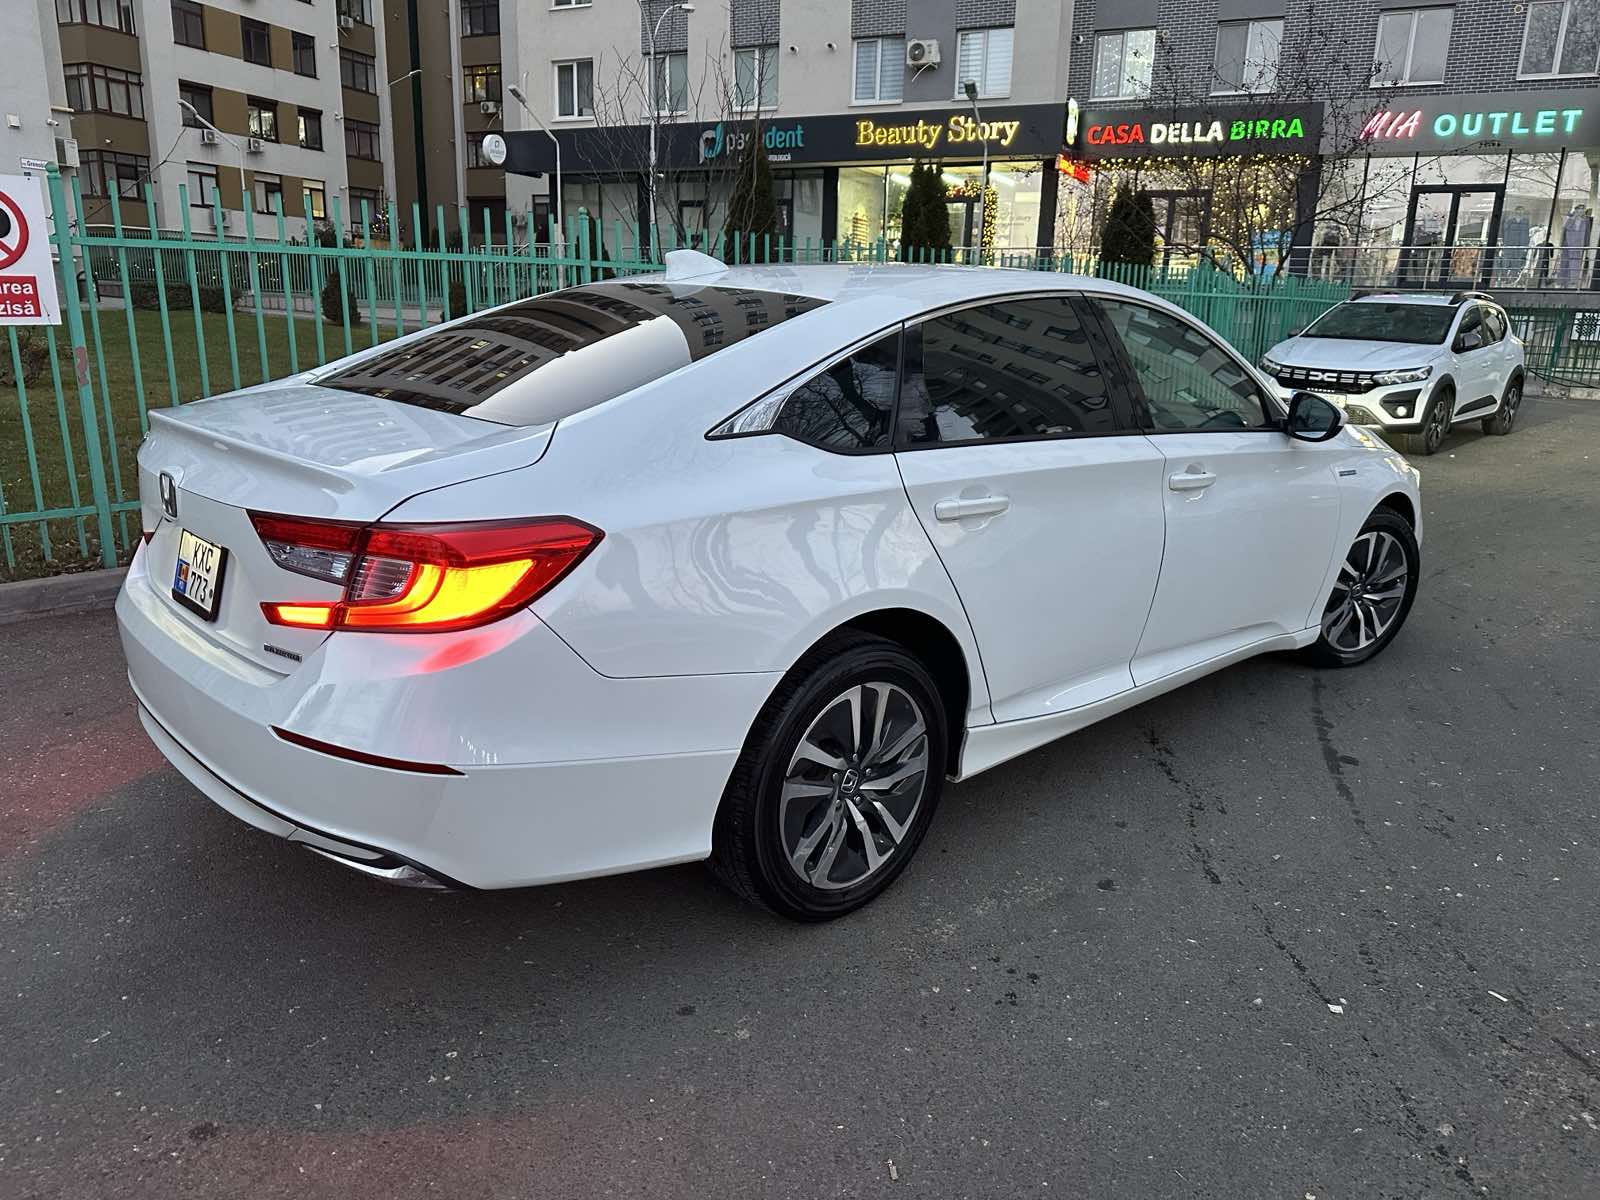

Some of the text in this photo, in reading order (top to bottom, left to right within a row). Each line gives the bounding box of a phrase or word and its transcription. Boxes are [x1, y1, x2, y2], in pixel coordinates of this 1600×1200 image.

[855, 115, 1020, 149] Beauty Story
[1086, 118, 1305, 145] CASA DELLA BIRRA
[1359, 109, 1583, 139] MIA OUTLET
[0, 282, 34, 295] rea
[193, 541, 214, 574] KXC
[189, 571, 209, 603] 773
